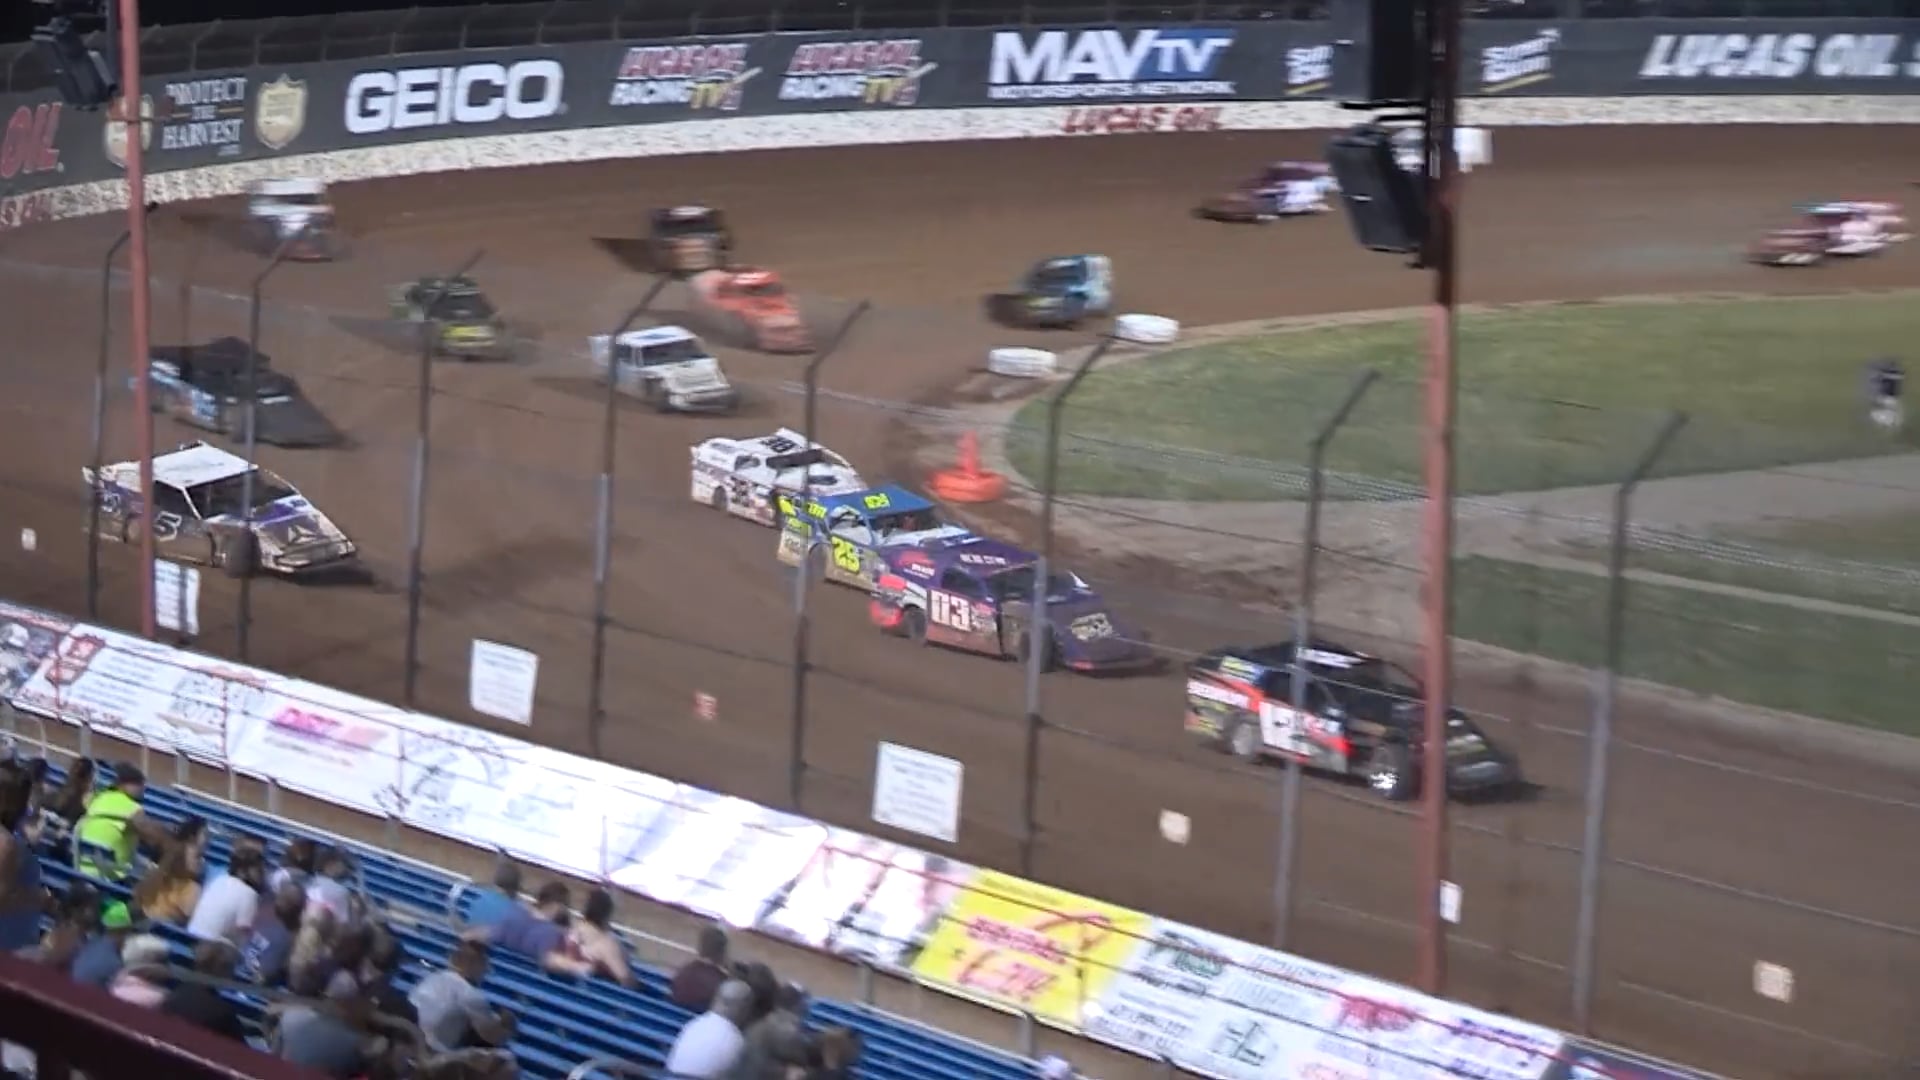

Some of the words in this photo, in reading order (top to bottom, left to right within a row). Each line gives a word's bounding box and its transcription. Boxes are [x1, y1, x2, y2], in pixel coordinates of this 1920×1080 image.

[1638, 33, 1816, 78] LUCAS
[1814, 33, 1901, 77] OIL
[165, 76, 248, 105] PROTECT
[344, 60, 564, 134] GEICO
[161, 119, 244, 149] HARVEST
[930, 589, 973, 632] 03
